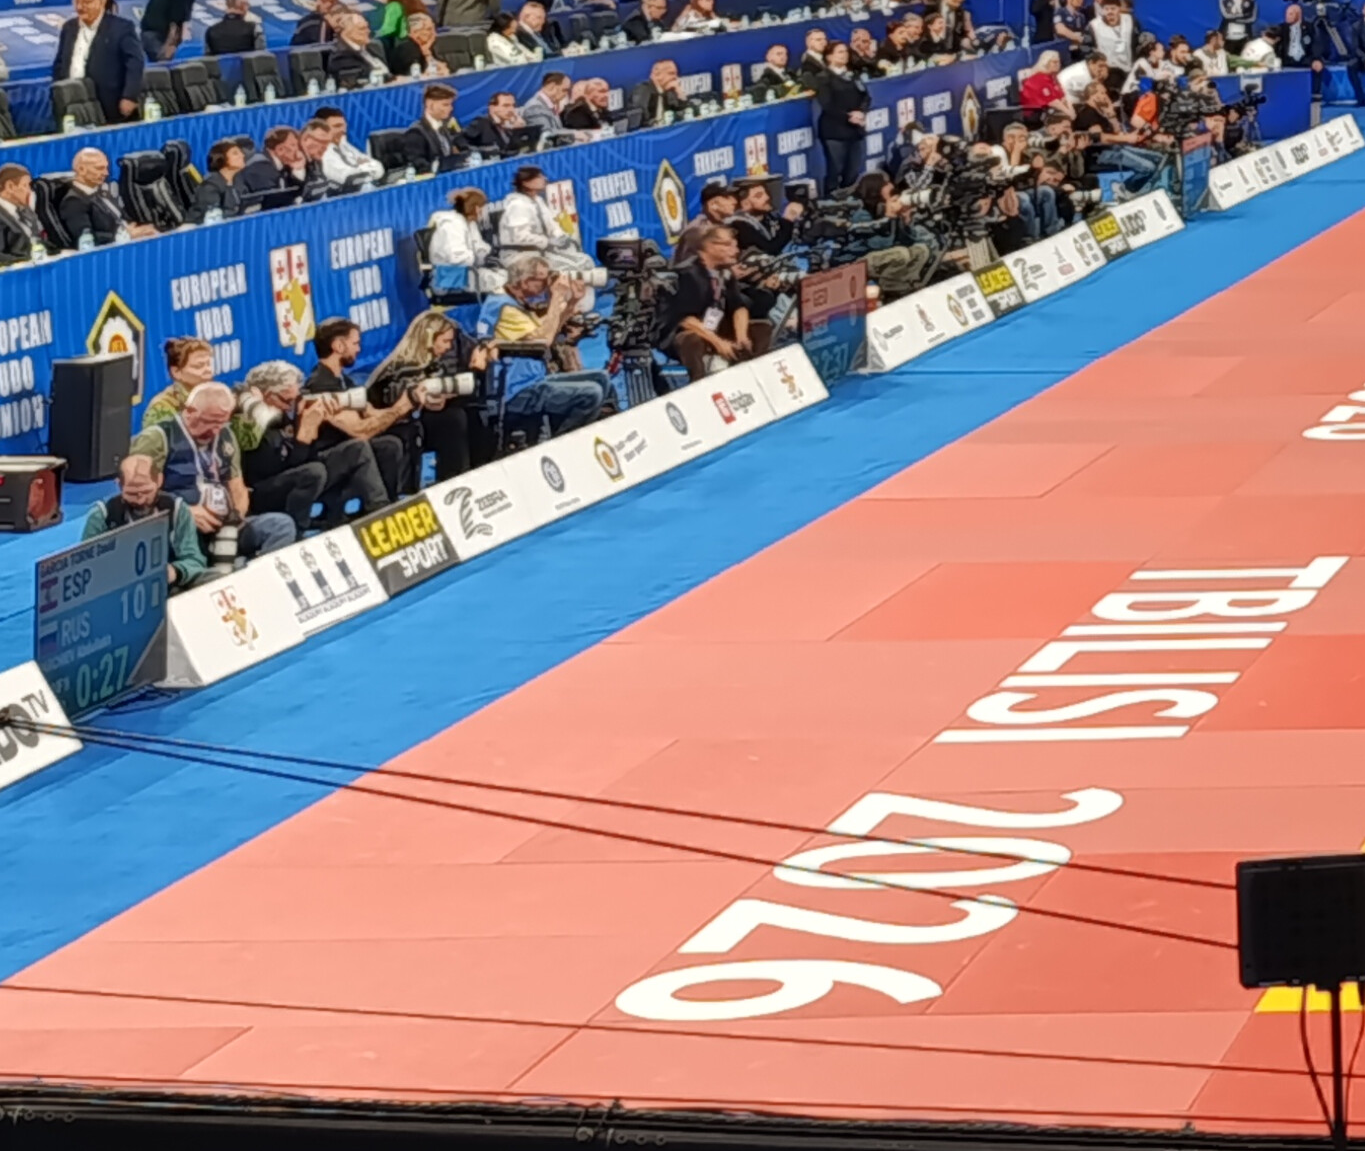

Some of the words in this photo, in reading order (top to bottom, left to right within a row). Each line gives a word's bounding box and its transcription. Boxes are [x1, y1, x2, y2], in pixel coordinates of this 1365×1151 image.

[330, 227, 396, 270] EUROPEAN
[171, 262, 248, 311] EUROPEAN
[348, 264, 383, 300] JUDO
[194, 303, 234, 341] JUDO
[360, 501, 439, 559] LEADER
[400, 533, 450, 579] SPORT
[62, 567, 93, 603] ESP
[134, 540, 147, 577] 0
[60, 610, 91, 648] RUS
[120, 581, 146, 625] 10
[76, 644, 130, 708] 0:27
[933, 555, 1350, 744] TBILISI
[21, 688, 50, 718] TV
[614, 786, 1125, 1021] 2026
